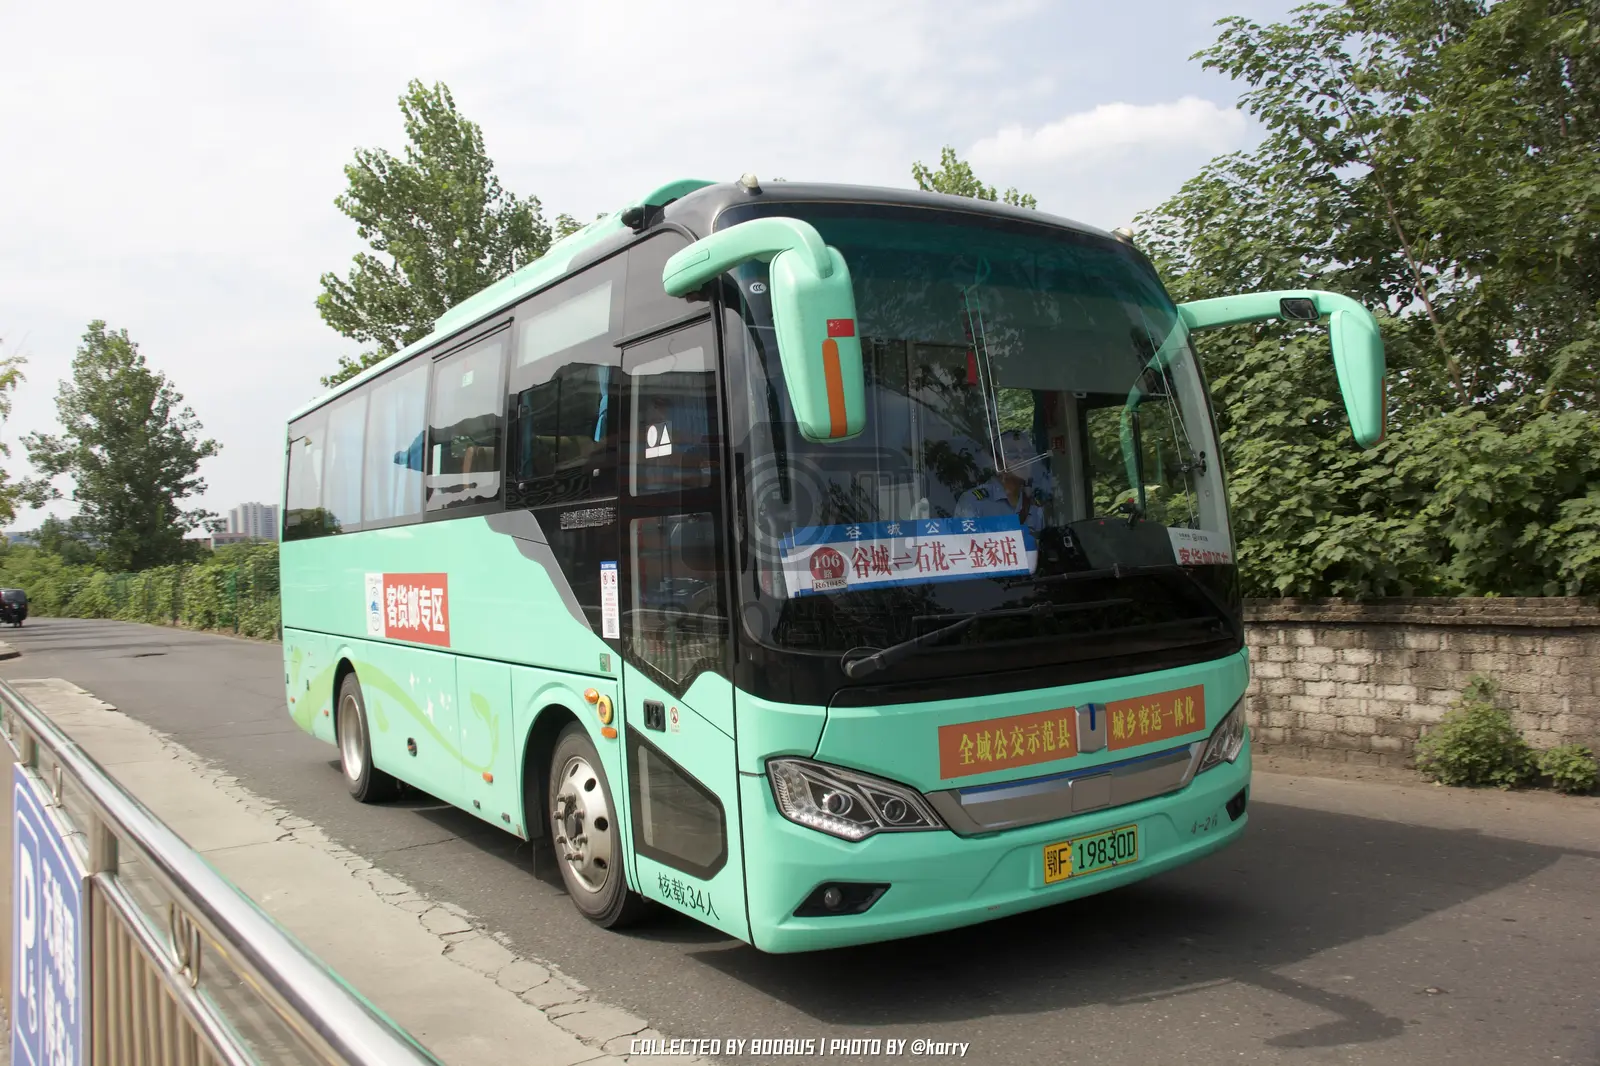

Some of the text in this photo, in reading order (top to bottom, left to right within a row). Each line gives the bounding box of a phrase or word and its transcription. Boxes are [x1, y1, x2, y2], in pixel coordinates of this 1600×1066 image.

[846, 519, 977, 537] 谷城公交
[814, 554, 841, 569] 106
[823, 569, 834, 579] 路
[851, 537, 1019, 579] 谷城 石花 金家店
[386, 584, 446, 632] 客货邮专区
[1112, 695, 1196, 741] 城乡客运一体化
[959, 718, 1071, 766] 全域公交示范县
[1047, 831, 1136, 878] 鄂F 19830D
[657, 872, 720, 921] 核载34人
[20, 842, 35, 999] P
